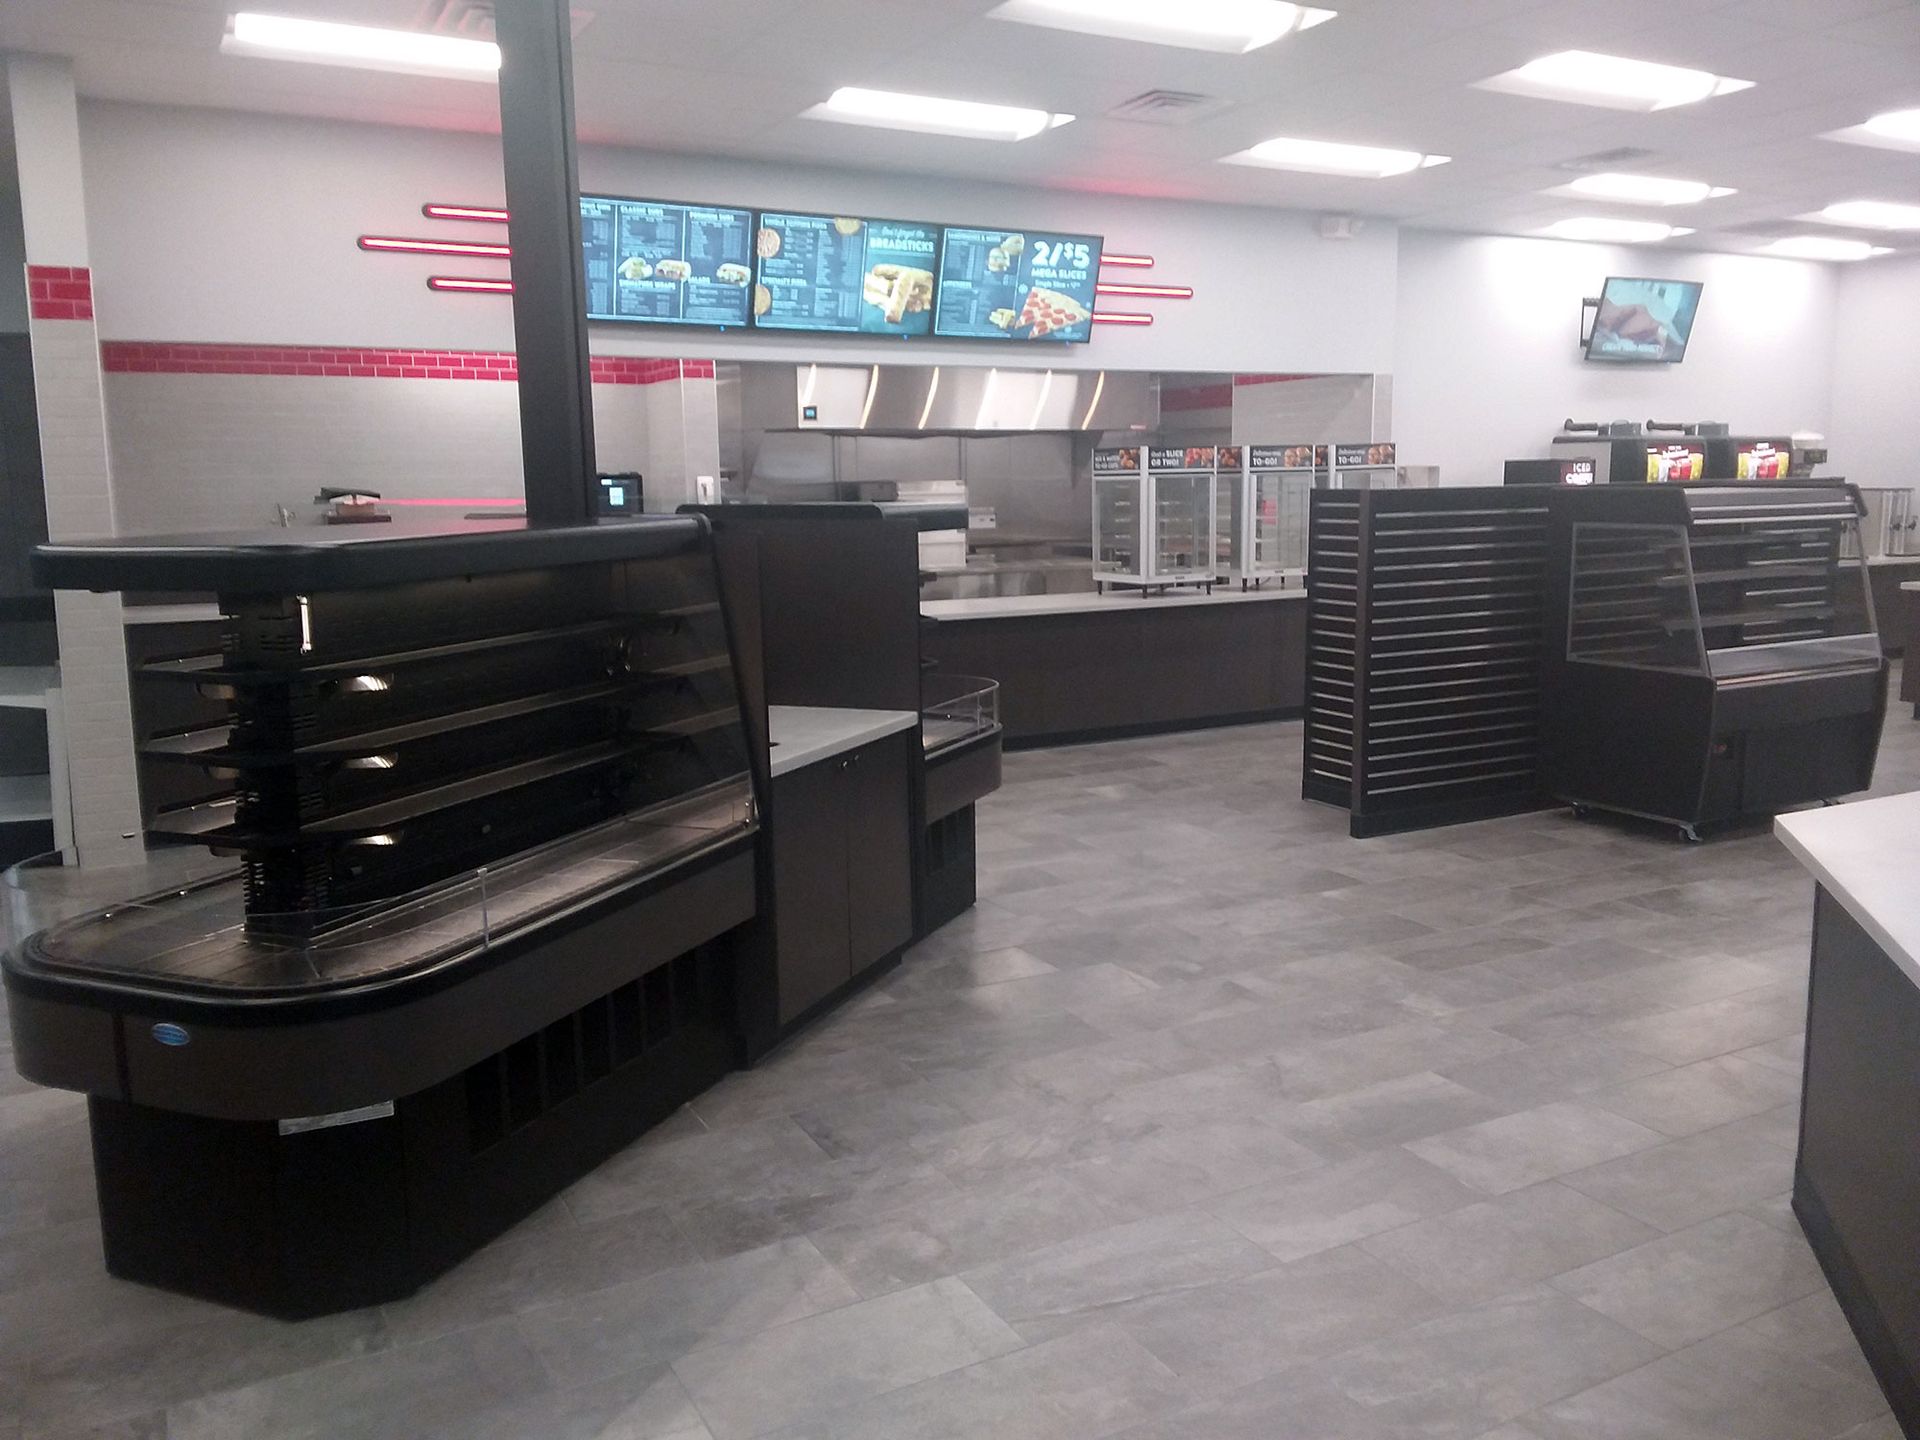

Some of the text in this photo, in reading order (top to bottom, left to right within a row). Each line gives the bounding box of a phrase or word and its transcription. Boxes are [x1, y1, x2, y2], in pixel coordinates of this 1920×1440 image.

[869, 237, 934, 253] BREADSTICKS
[1031, 240, 1090, 270] 2/$5
[1031, 267, 1087, 281] MEGA SLICES
[1166, 449, 1184, 458] SLICE
[1150, 458, 1161, 467] OR
[1572, 462, 1592, 473] ICED
